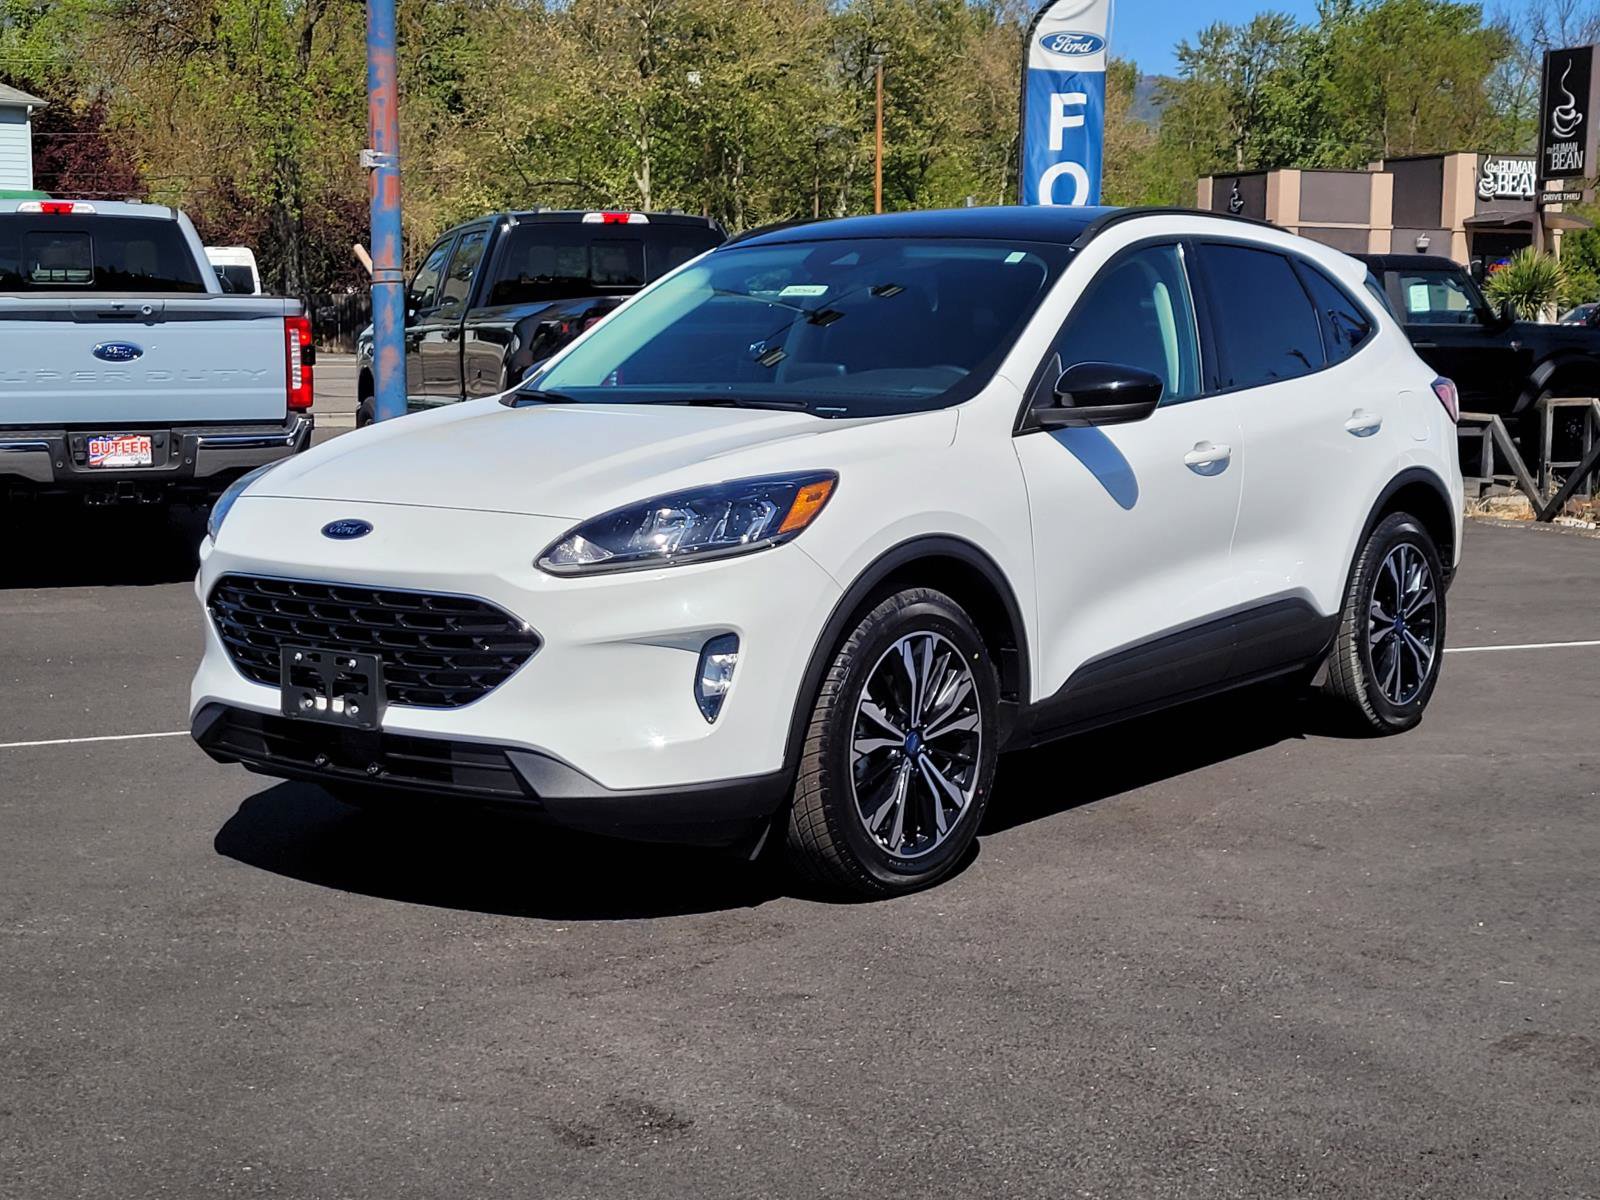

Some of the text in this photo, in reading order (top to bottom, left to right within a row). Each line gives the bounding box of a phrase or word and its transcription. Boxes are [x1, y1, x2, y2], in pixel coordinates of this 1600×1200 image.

[1051, 34, 1094, 53] Ford
[1552, 142, 1578, 153] HUMAN
[1499, 160, 1536, 174] HUMAN
[1551, 151, 1584, 170] BEAN
[1543, 192, 1581, 201] DRIVE THRU
[145, 369, 267, 382] DUTY
[91, 441, 150, 455] BUTLER
